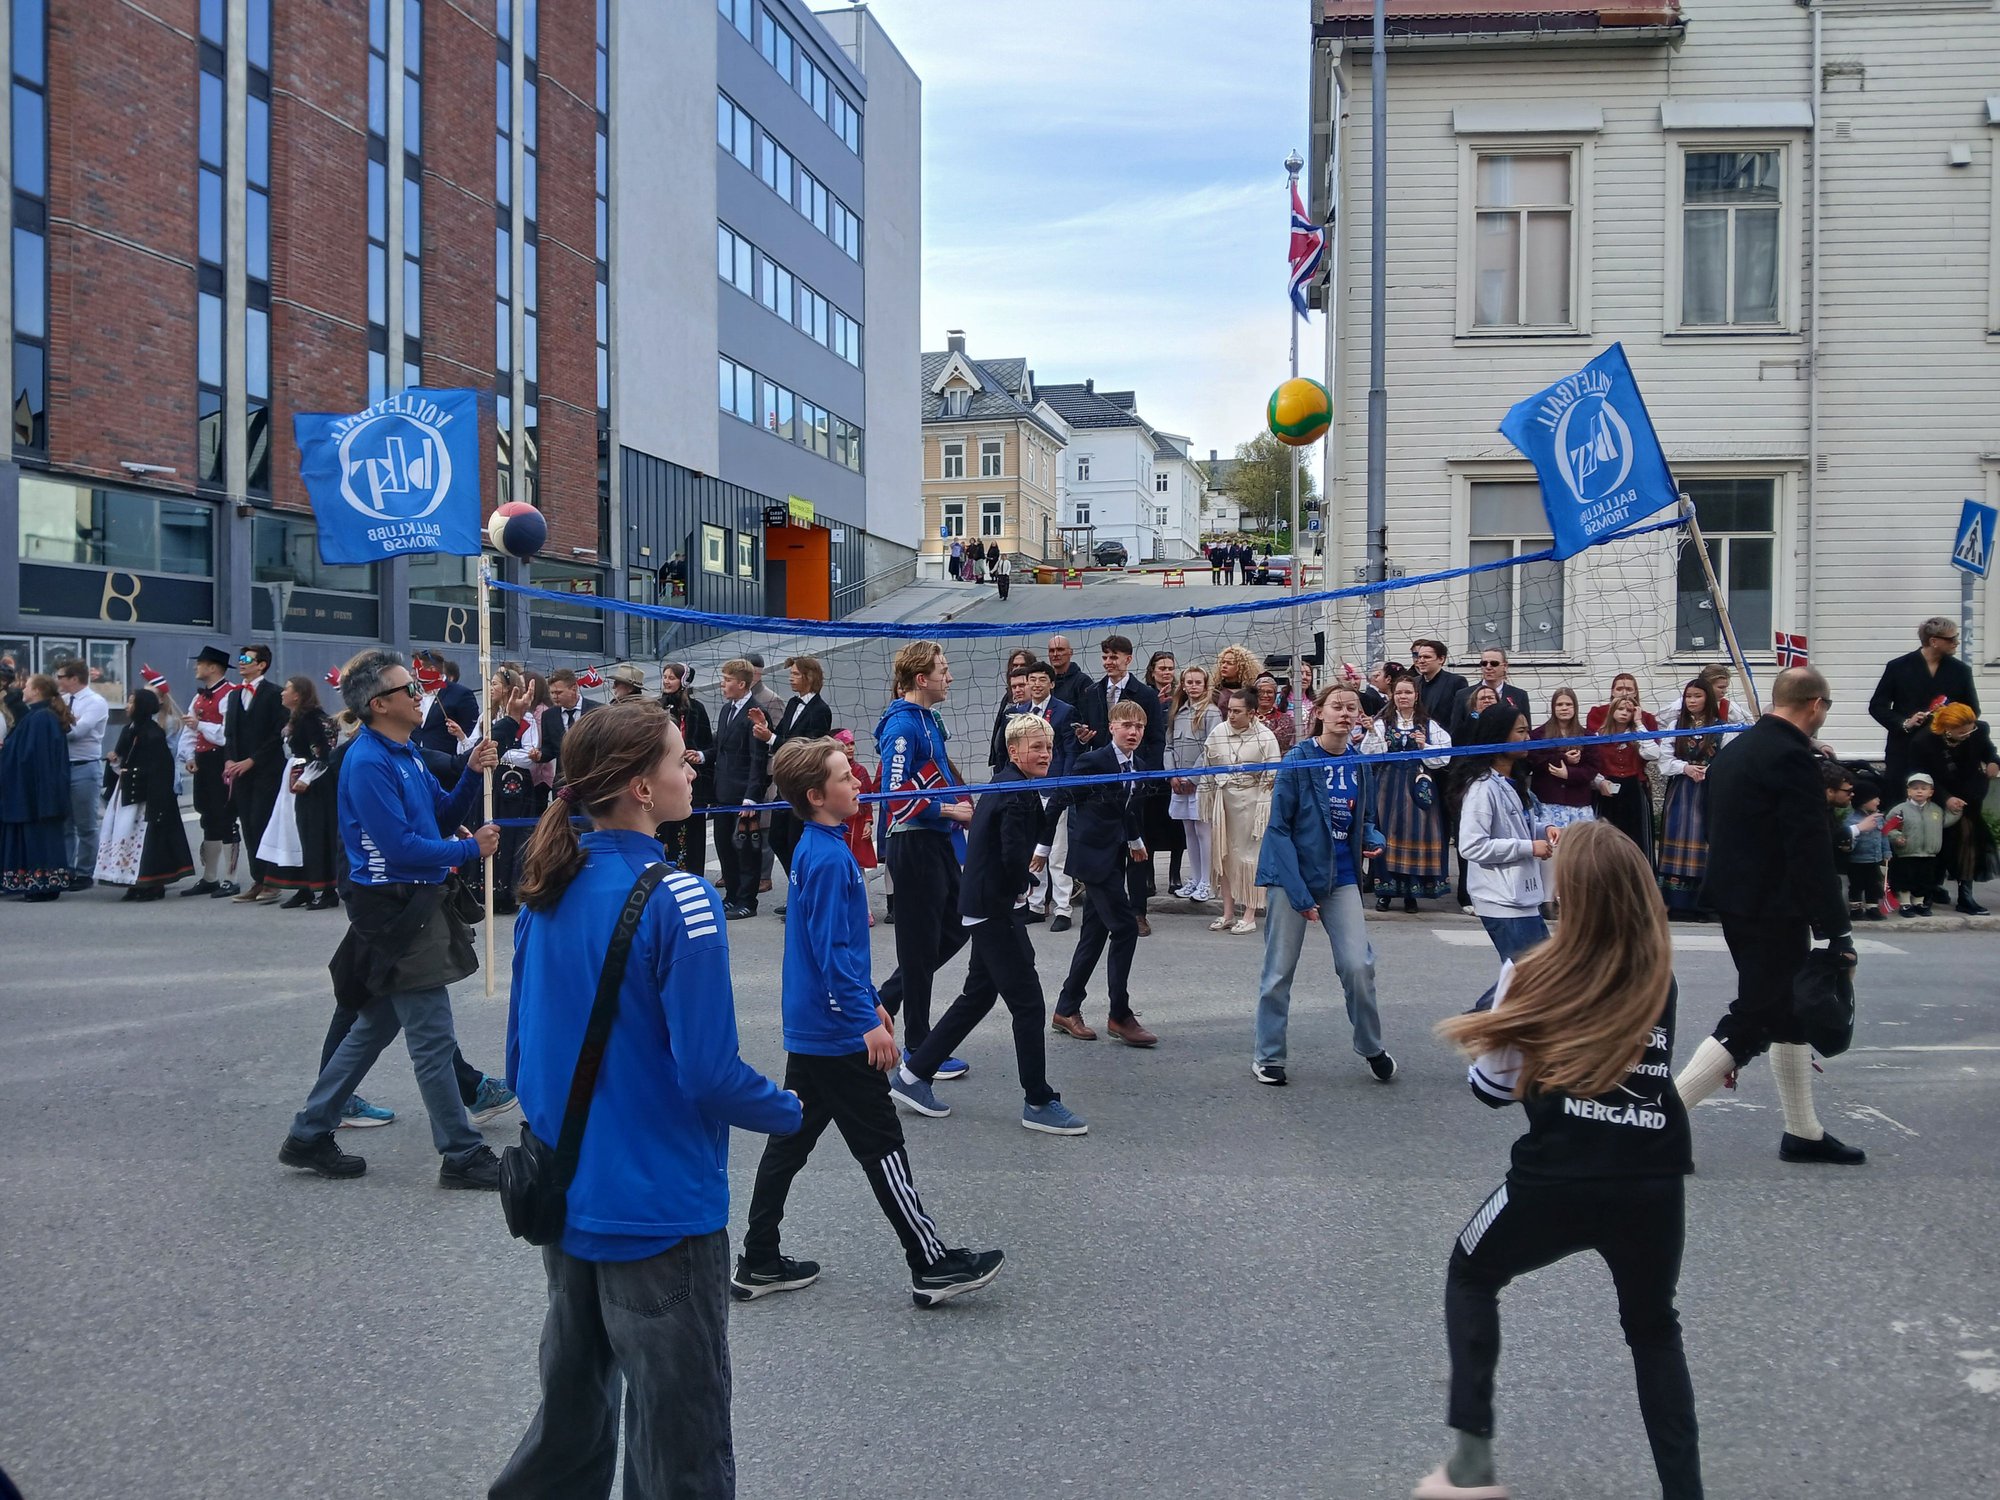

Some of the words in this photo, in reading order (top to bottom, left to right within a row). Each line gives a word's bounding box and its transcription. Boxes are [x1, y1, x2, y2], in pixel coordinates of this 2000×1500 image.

[1324, 765, 1347, 790] 21
[1644, 1032, 1668, 1051] OR
[1564, 1097, 1667, 1130] NERGÅRD
